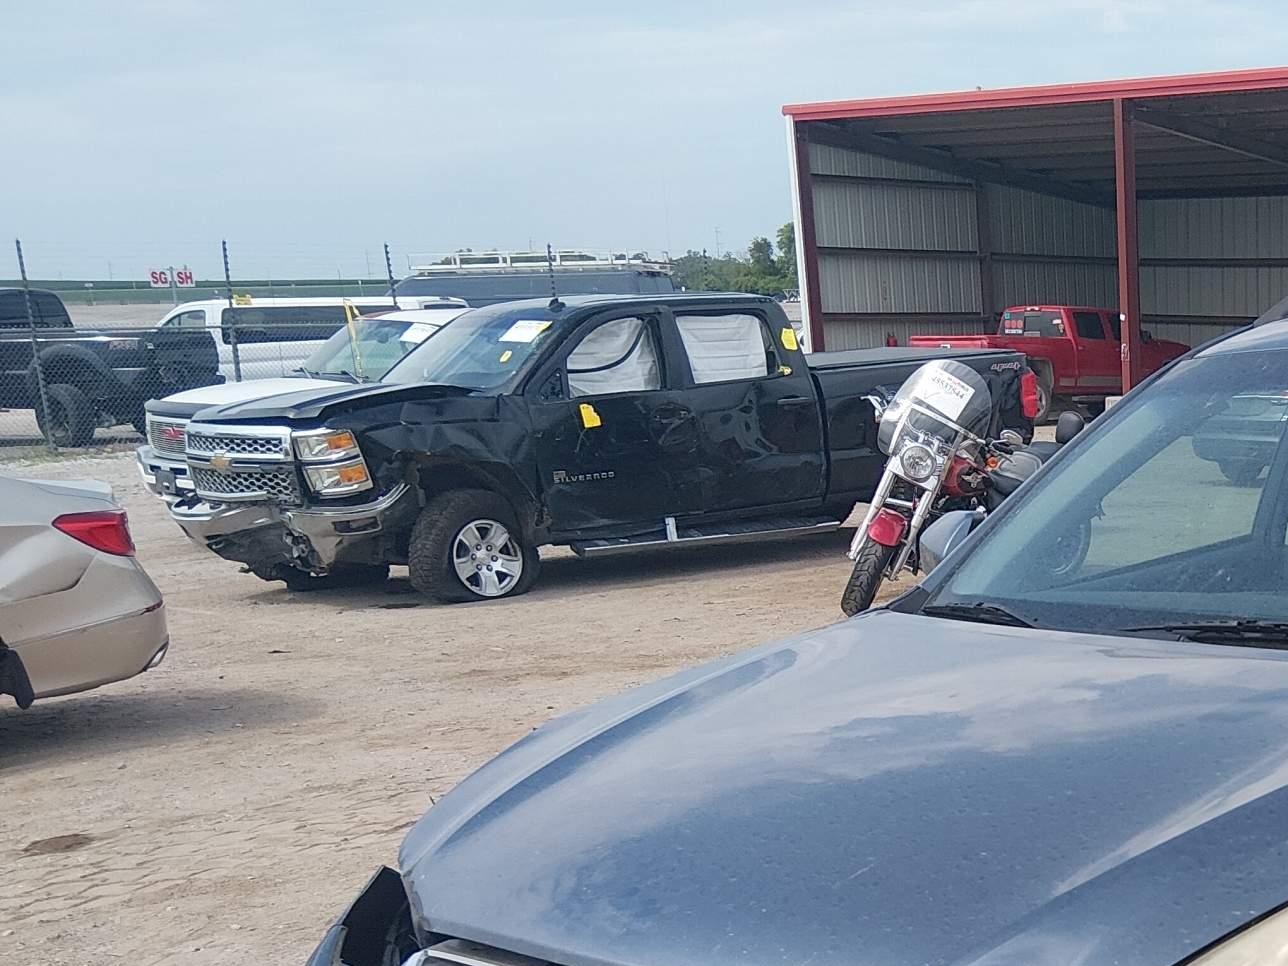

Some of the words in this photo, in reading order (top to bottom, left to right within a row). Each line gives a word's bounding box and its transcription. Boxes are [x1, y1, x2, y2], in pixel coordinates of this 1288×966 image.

[151, 271, 168, 285] SG
[176, 271, 194, 285] SH
[553, 471, 616, 484] SILVERADO
